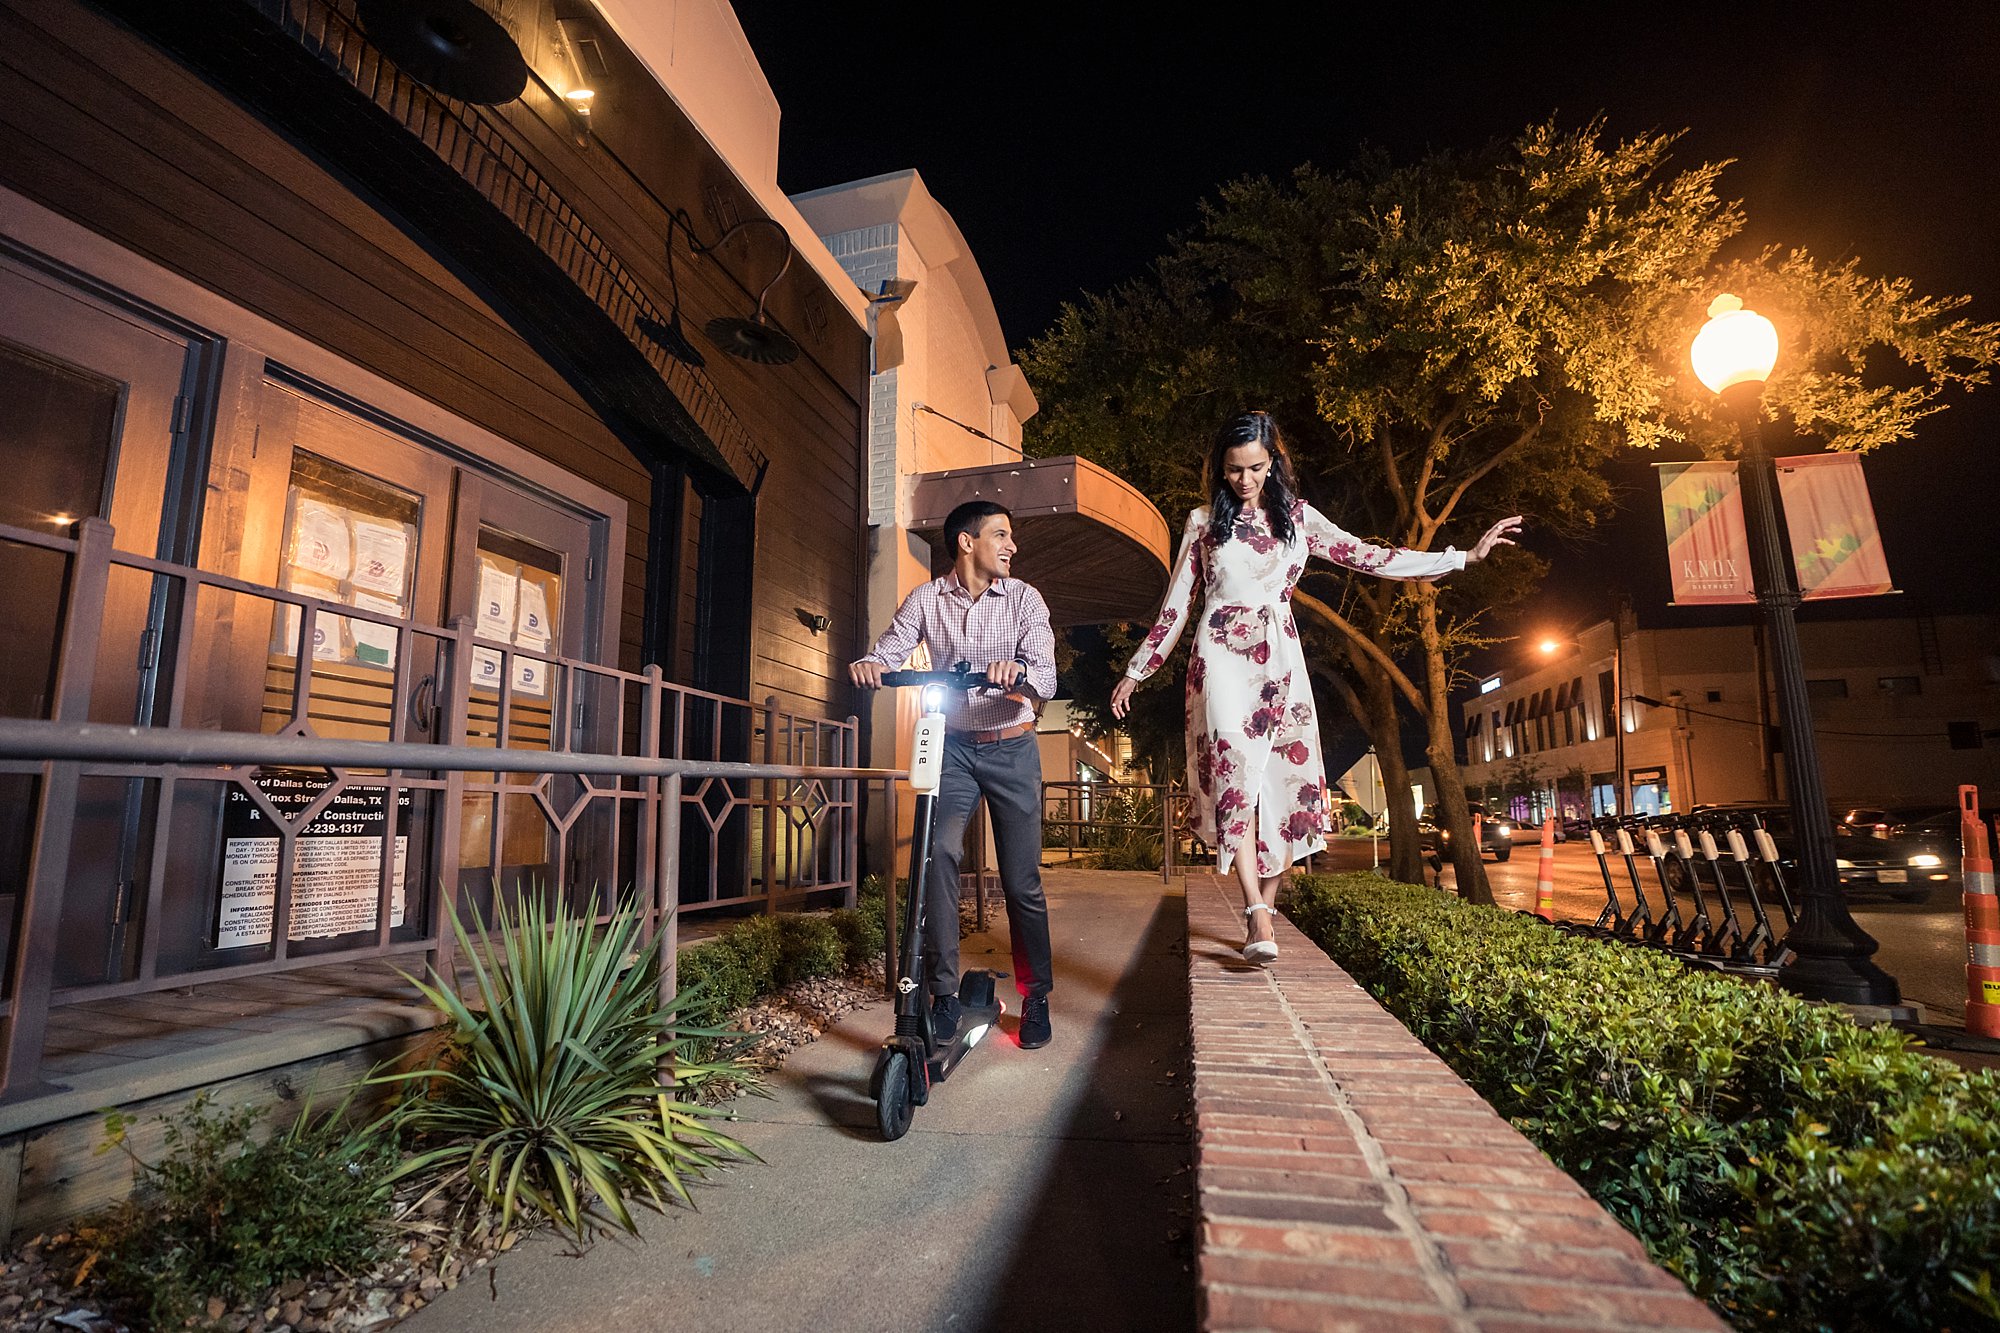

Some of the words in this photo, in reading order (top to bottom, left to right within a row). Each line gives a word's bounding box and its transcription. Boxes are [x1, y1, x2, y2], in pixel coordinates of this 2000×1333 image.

[1684, 560, 1738, 578] KNOX
[919, 728, 930, 764] BIRD
[334, 796, 366, 806] Dallas,
[369, 796, 382, 805] TX
